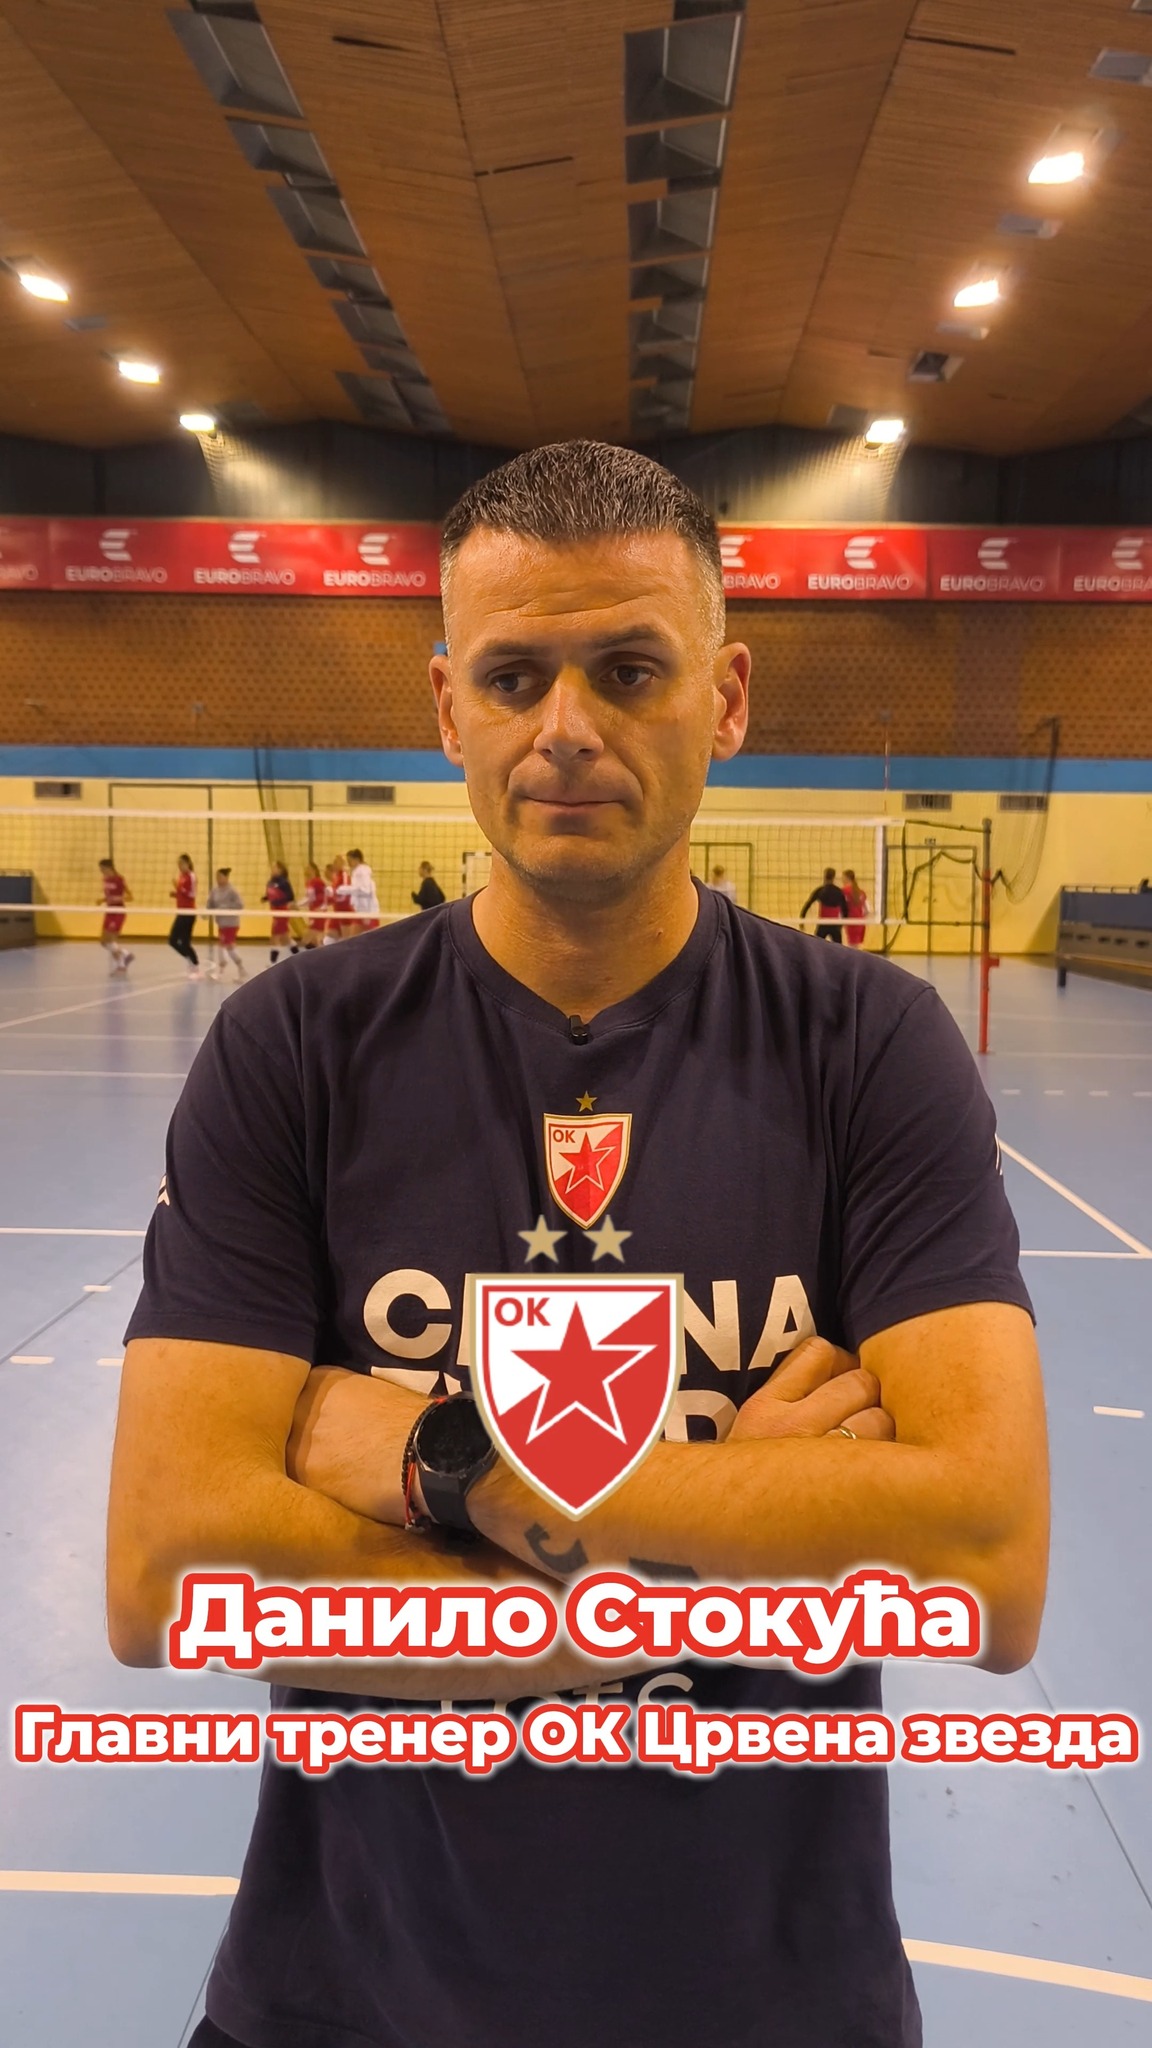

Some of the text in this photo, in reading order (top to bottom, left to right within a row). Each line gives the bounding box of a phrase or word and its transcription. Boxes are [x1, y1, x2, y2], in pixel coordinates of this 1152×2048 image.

[65, 566, 168, 583] EUROBRAVO
[193, 568, 295, 585] EUROBRAVO
[323, 570, 426, 587] EUROBRAVO
[723, 573, 781, 589] BRAVO
[807, 573, 911, 591] EUROBRAVO
[940, 575, 1044, 592] EUROBRAVO
[552, 1129, 576, 1143] OK
